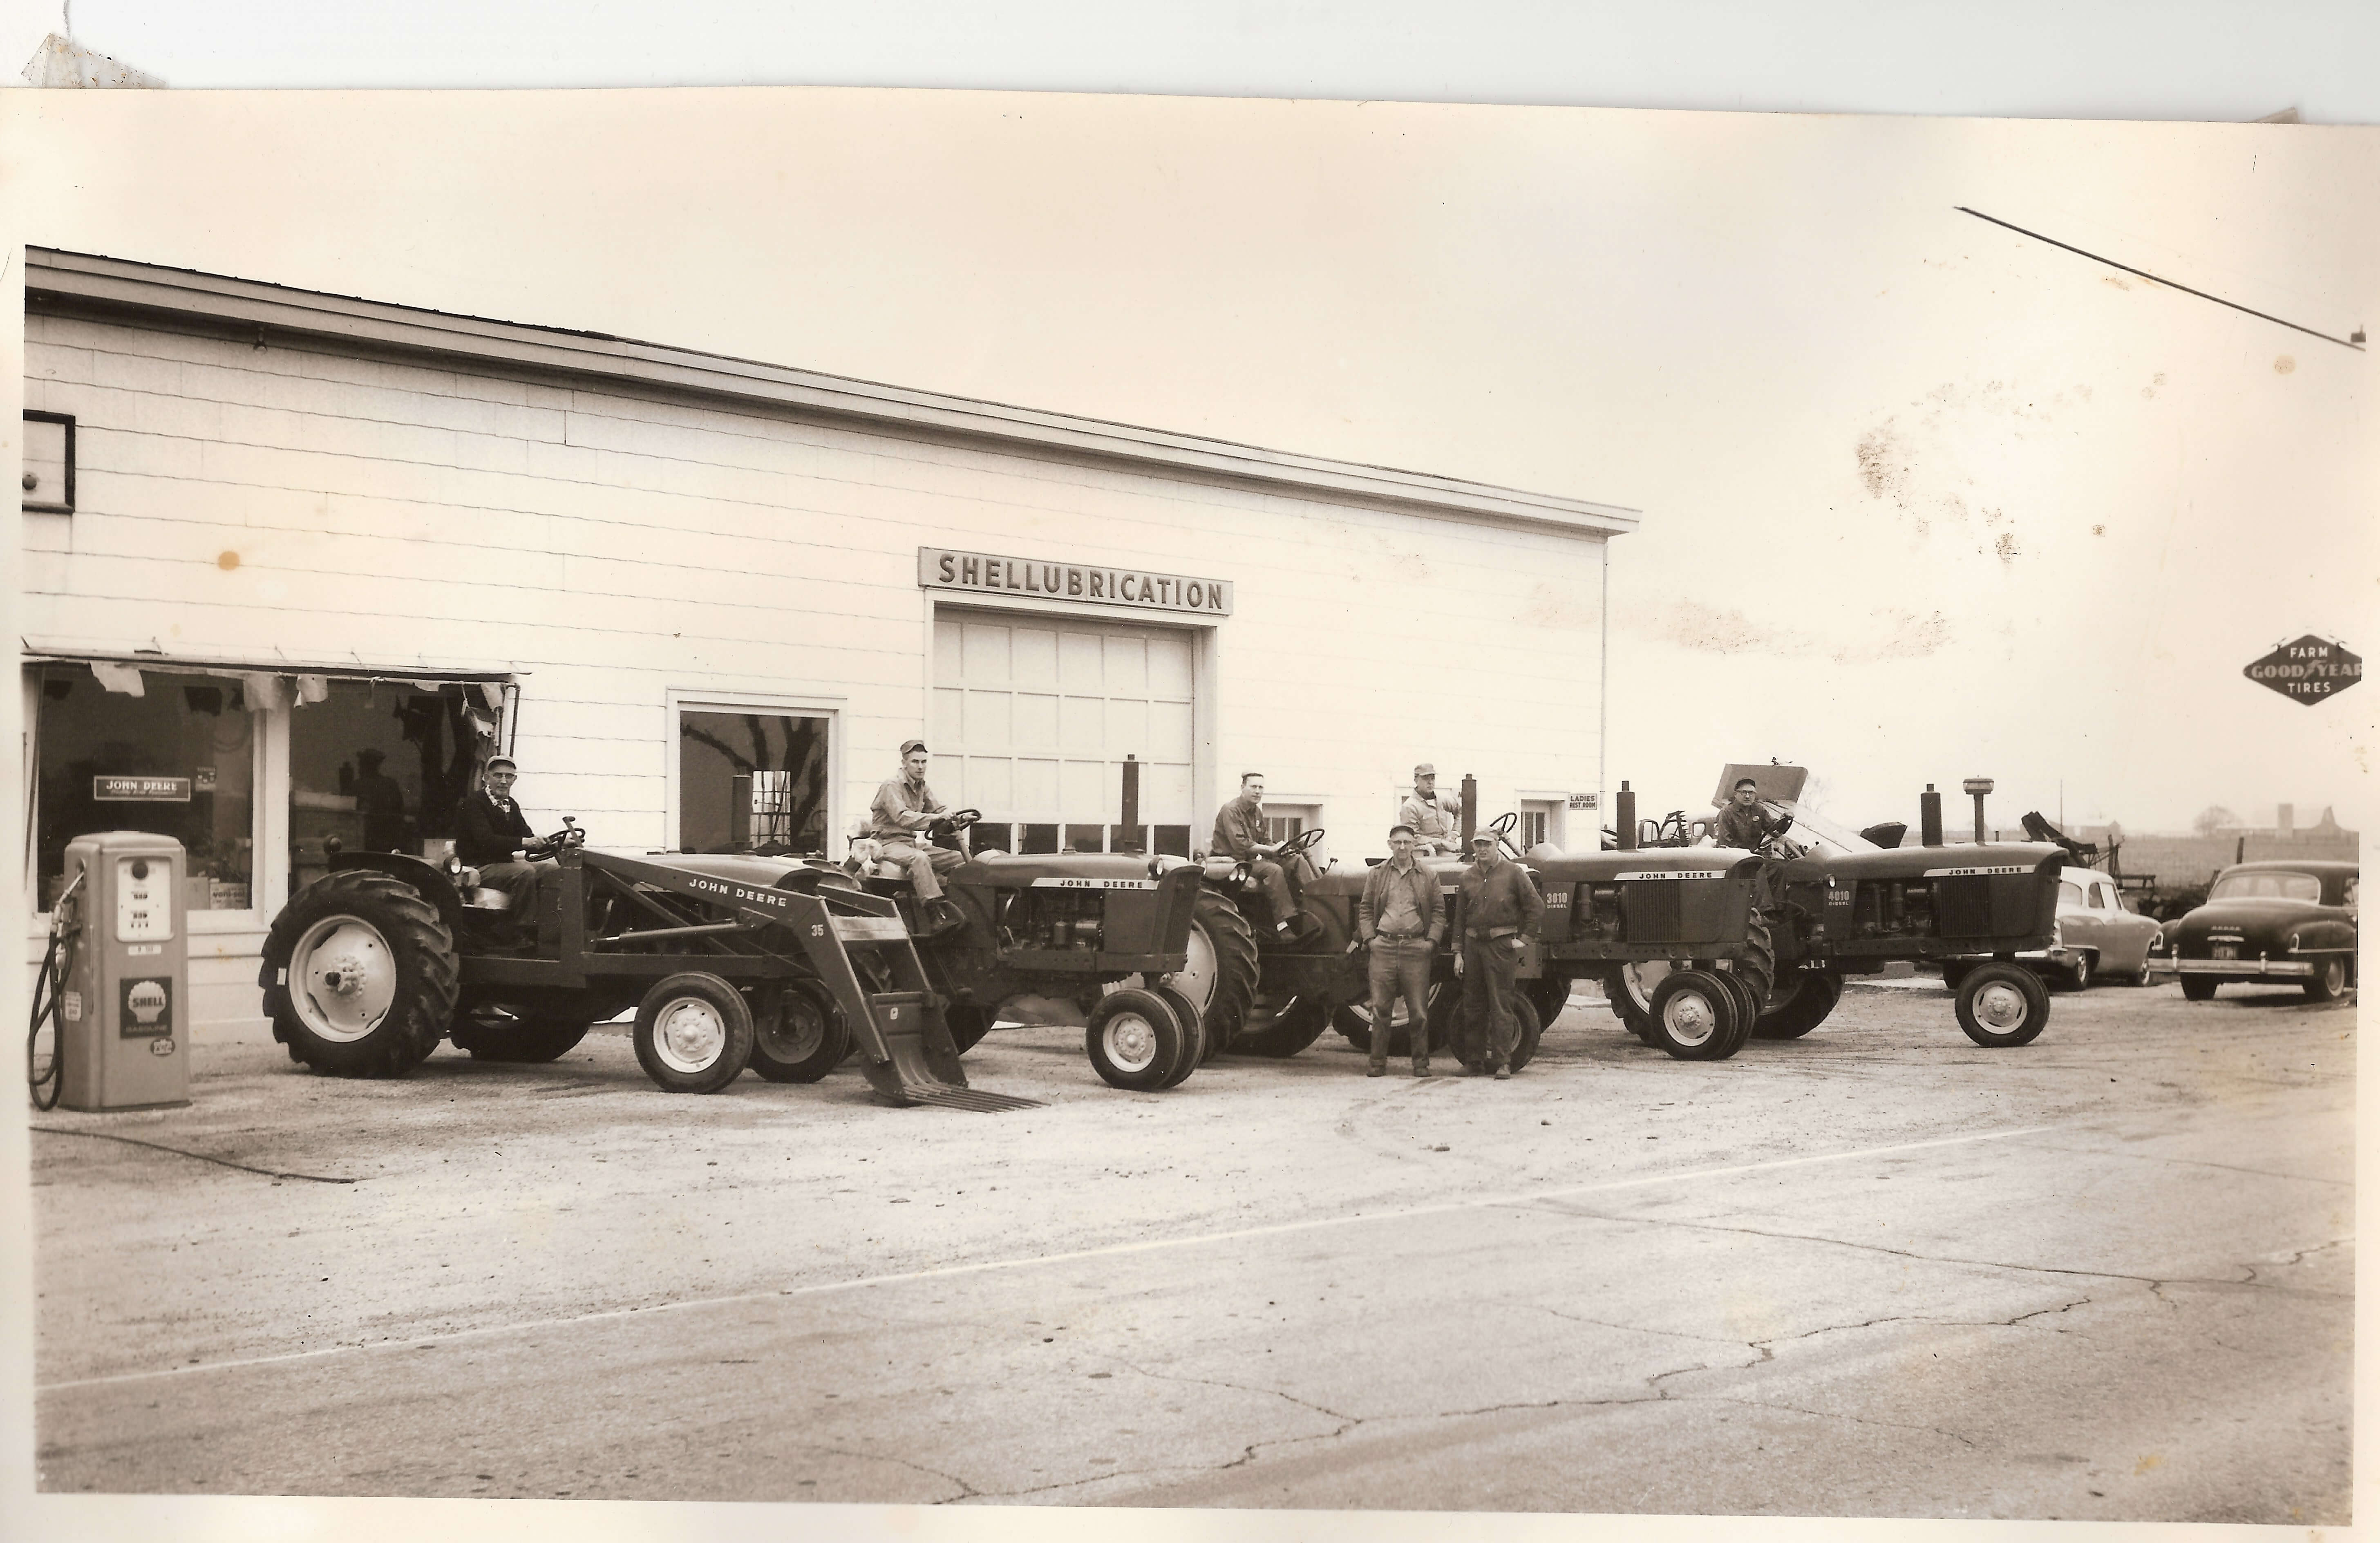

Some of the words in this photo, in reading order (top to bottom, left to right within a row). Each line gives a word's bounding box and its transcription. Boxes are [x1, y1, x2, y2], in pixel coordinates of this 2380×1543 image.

[939, 553, 1222, 610] SHELLUBRICATION
[2290, 647, 2328, 658] FARM
[2287, 682, 2331, 693] TIRES
[105, 780, 138, 790] JOHN
[143, 781, 177, 791] DEERE
[689, 879, 728, 894] JOHN
[736, 888, 787, 907] DEERE
[1546, 892, 1567, 903] 3010
[1828, 890, 1850, 901] 4010
[811, 924, 824, 937] 35
[132, 996, 163, 1007] SHELL
